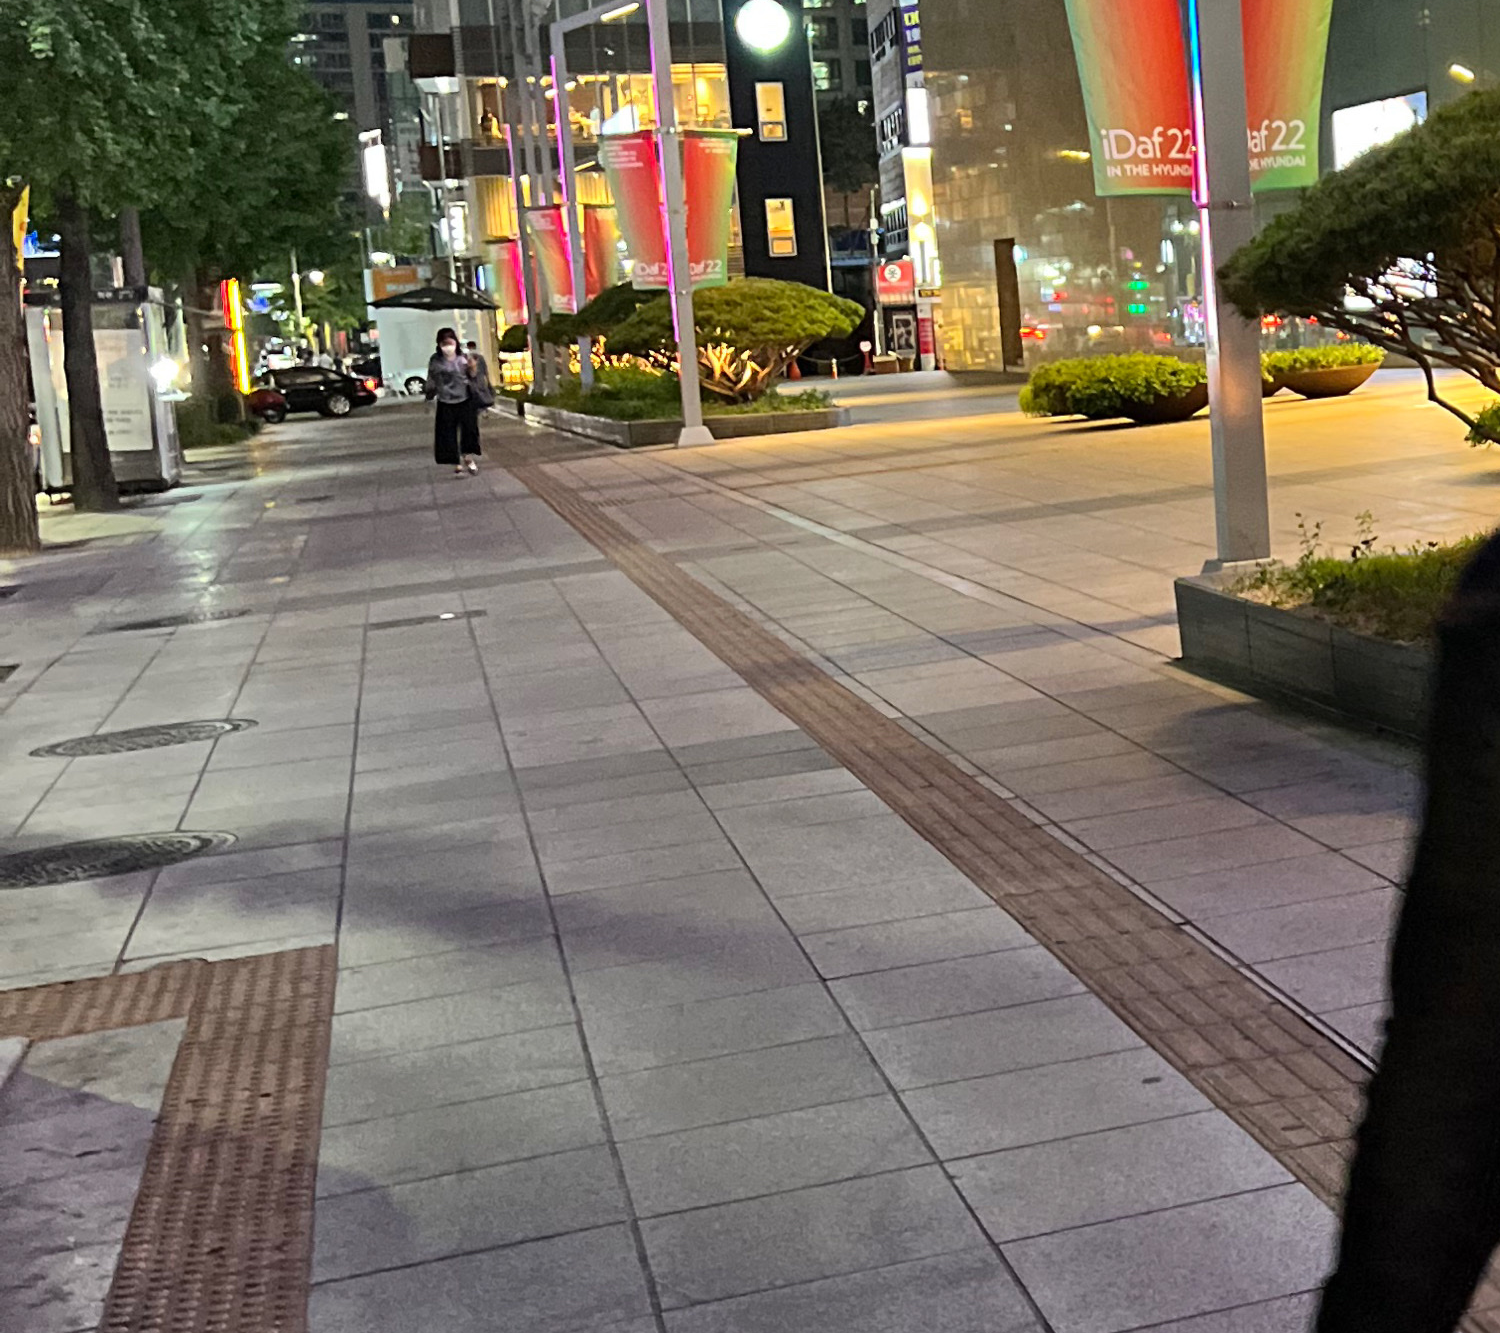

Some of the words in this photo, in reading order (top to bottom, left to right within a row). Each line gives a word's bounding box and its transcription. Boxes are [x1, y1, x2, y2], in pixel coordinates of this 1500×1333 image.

[1100, 126, 1163, 160] iDaf
[1271, 119, 1306, 151] 22
[1106, 165, 1122, 177] IN
[1124, 164, 1150, 176] THE
[1152, 163, 1192, 176] HYUND
[1261, 155, 1306, 169] HYUNDAI
